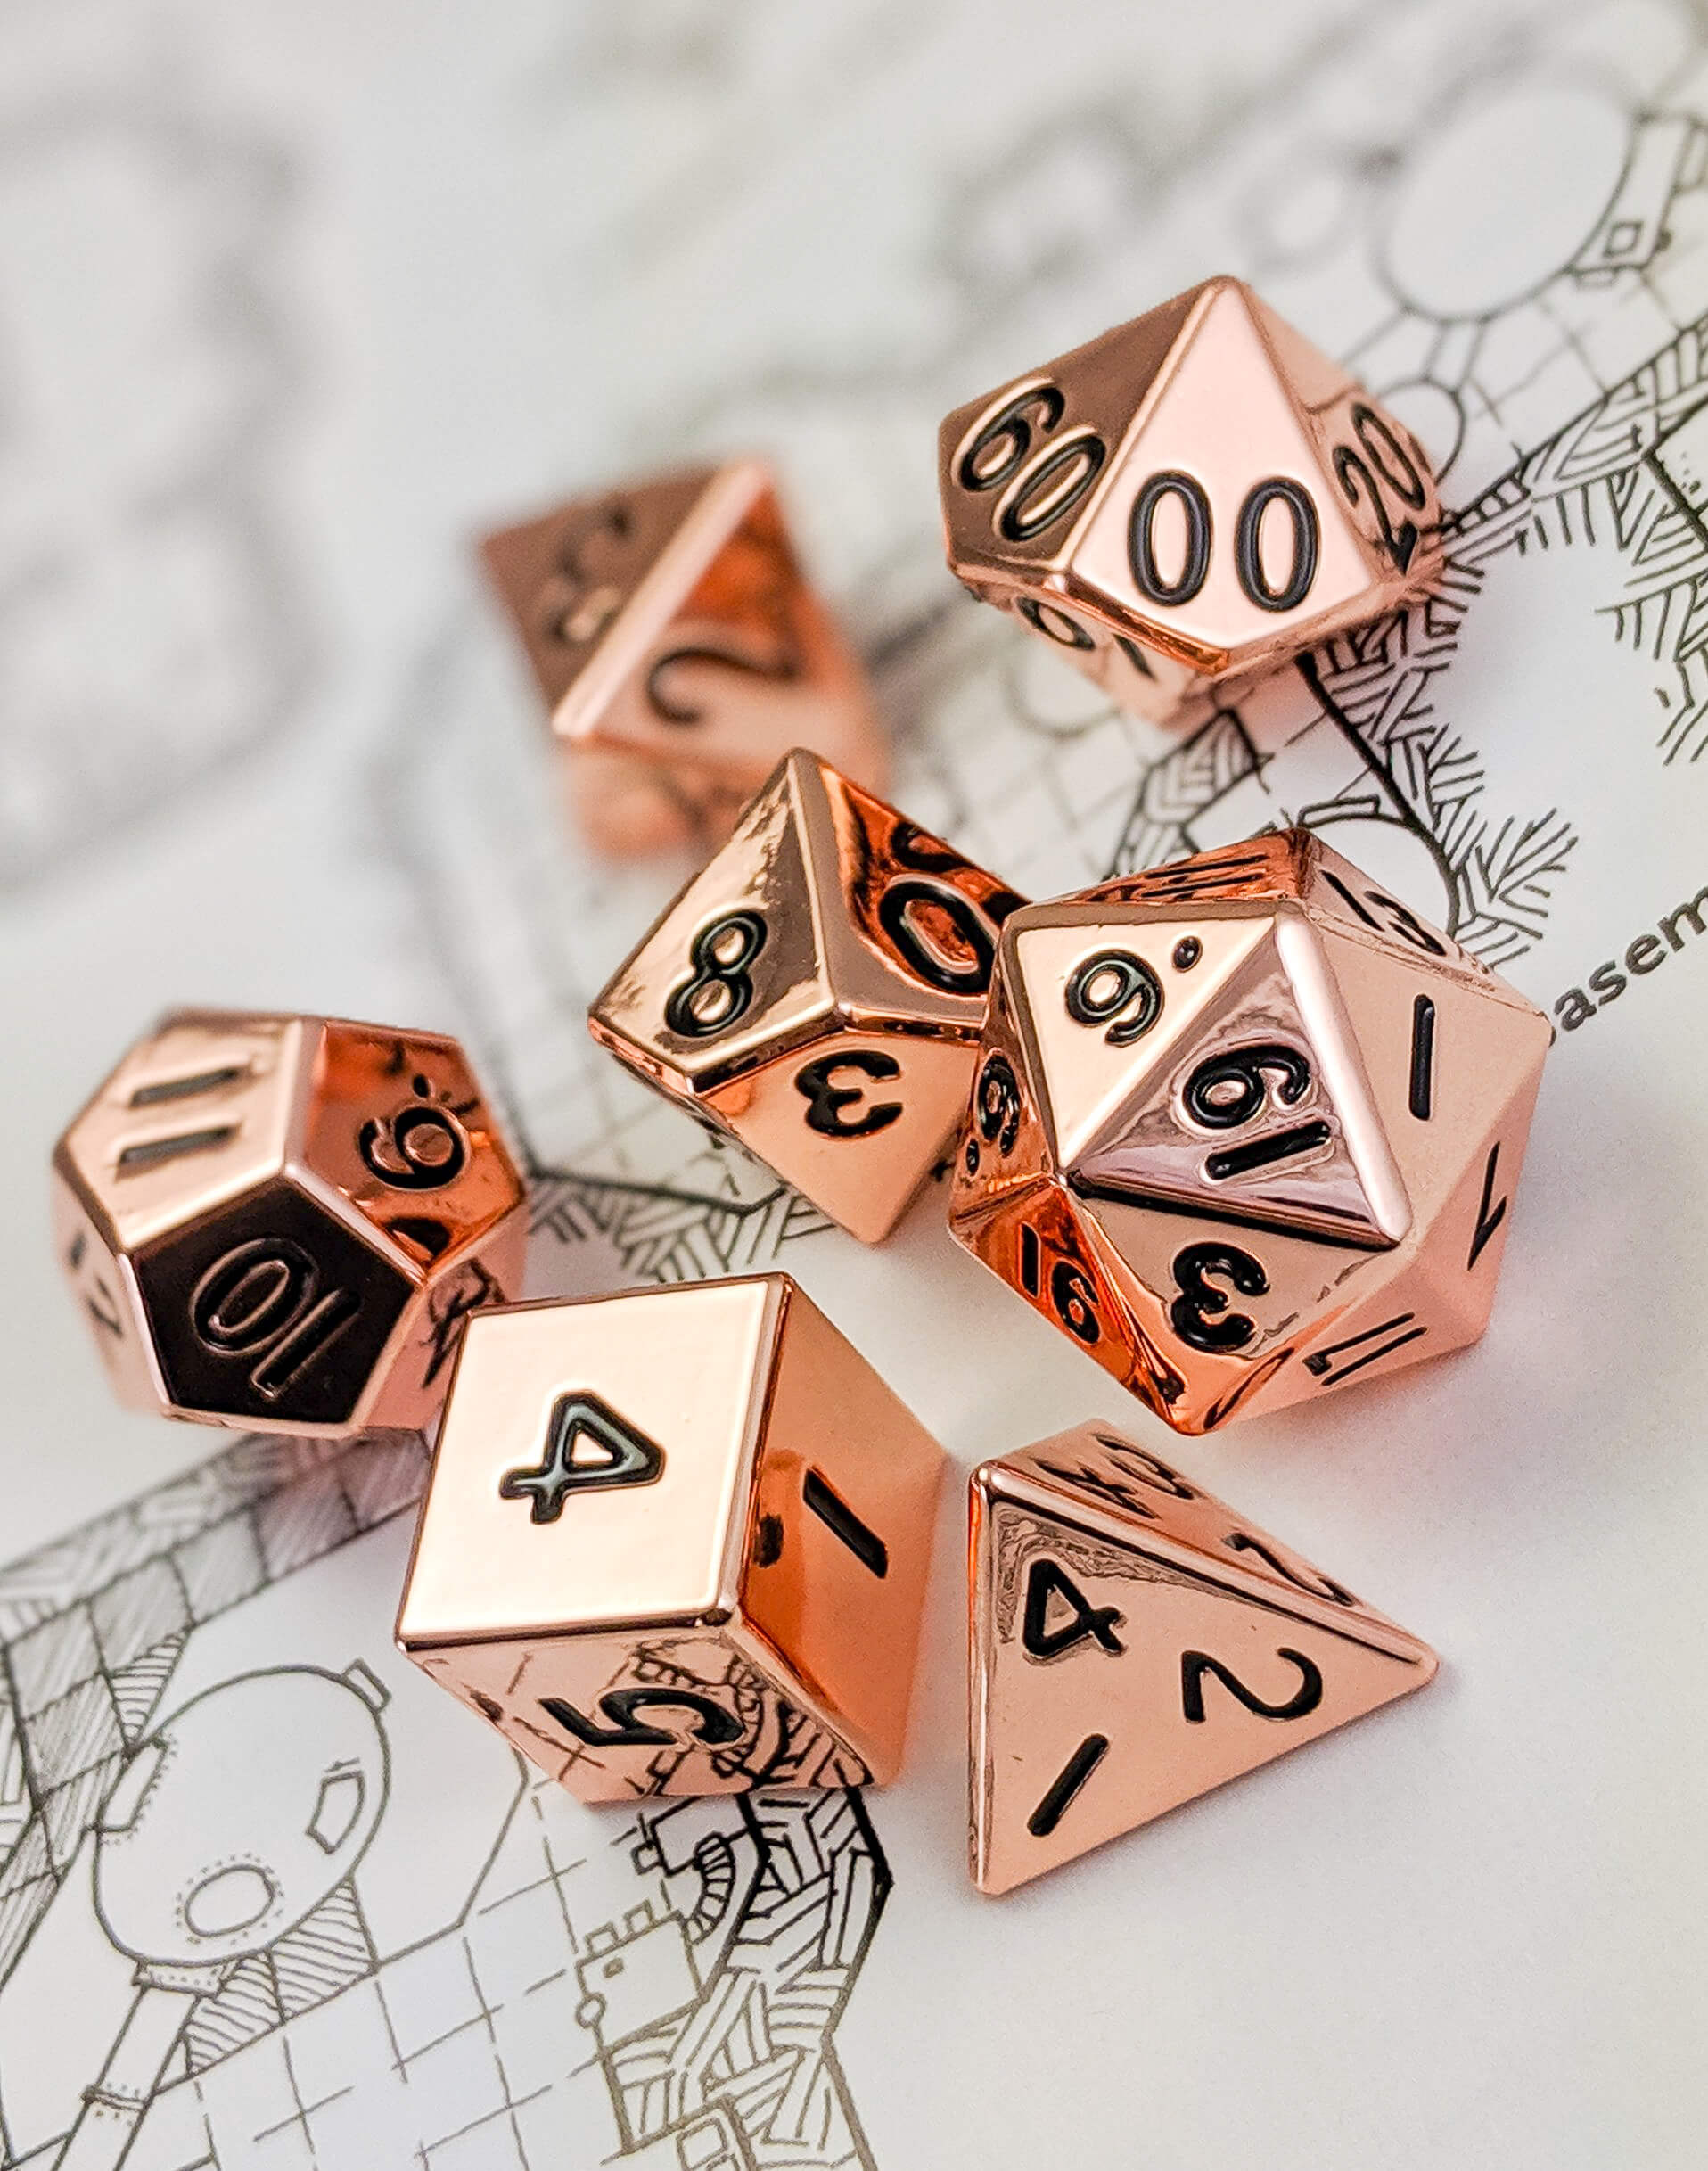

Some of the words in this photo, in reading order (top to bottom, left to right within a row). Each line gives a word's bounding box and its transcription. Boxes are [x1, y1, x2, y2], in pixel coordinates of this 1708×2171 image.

[955, 380, 1106, 542] 60
[1334, 402, 1426, 576] 20
[1129, 472, 1319, 613] 00
[663, 909, 768, 1039] 8
[878, 872, 998, 998] 0
[1320, 868, 1449, 956] 13
[1551, 884, 1708, 1040] asem
[117, 1065, 247, 1168] 11
[794, 1049, 905, 1138] 3
[1182, 1043, 1334, 1181] 19
[1408, 993, 1436, 1123] 1
[193, 1240, 363, 1400] 10
[1021, 1222, 1101, 1345] 16
[1170, 1241, 1272, 1354] 3
[498, 1392, 667, 1525] 4
[803, 1467, 890, 1579] 1
[1022, 1557, 1127, 1658] 4
[536, 1688, 749, 1749] 5
[1180, 1646, 1325, 1724] 2
[1025, 1732, 1113, 1838] 1
